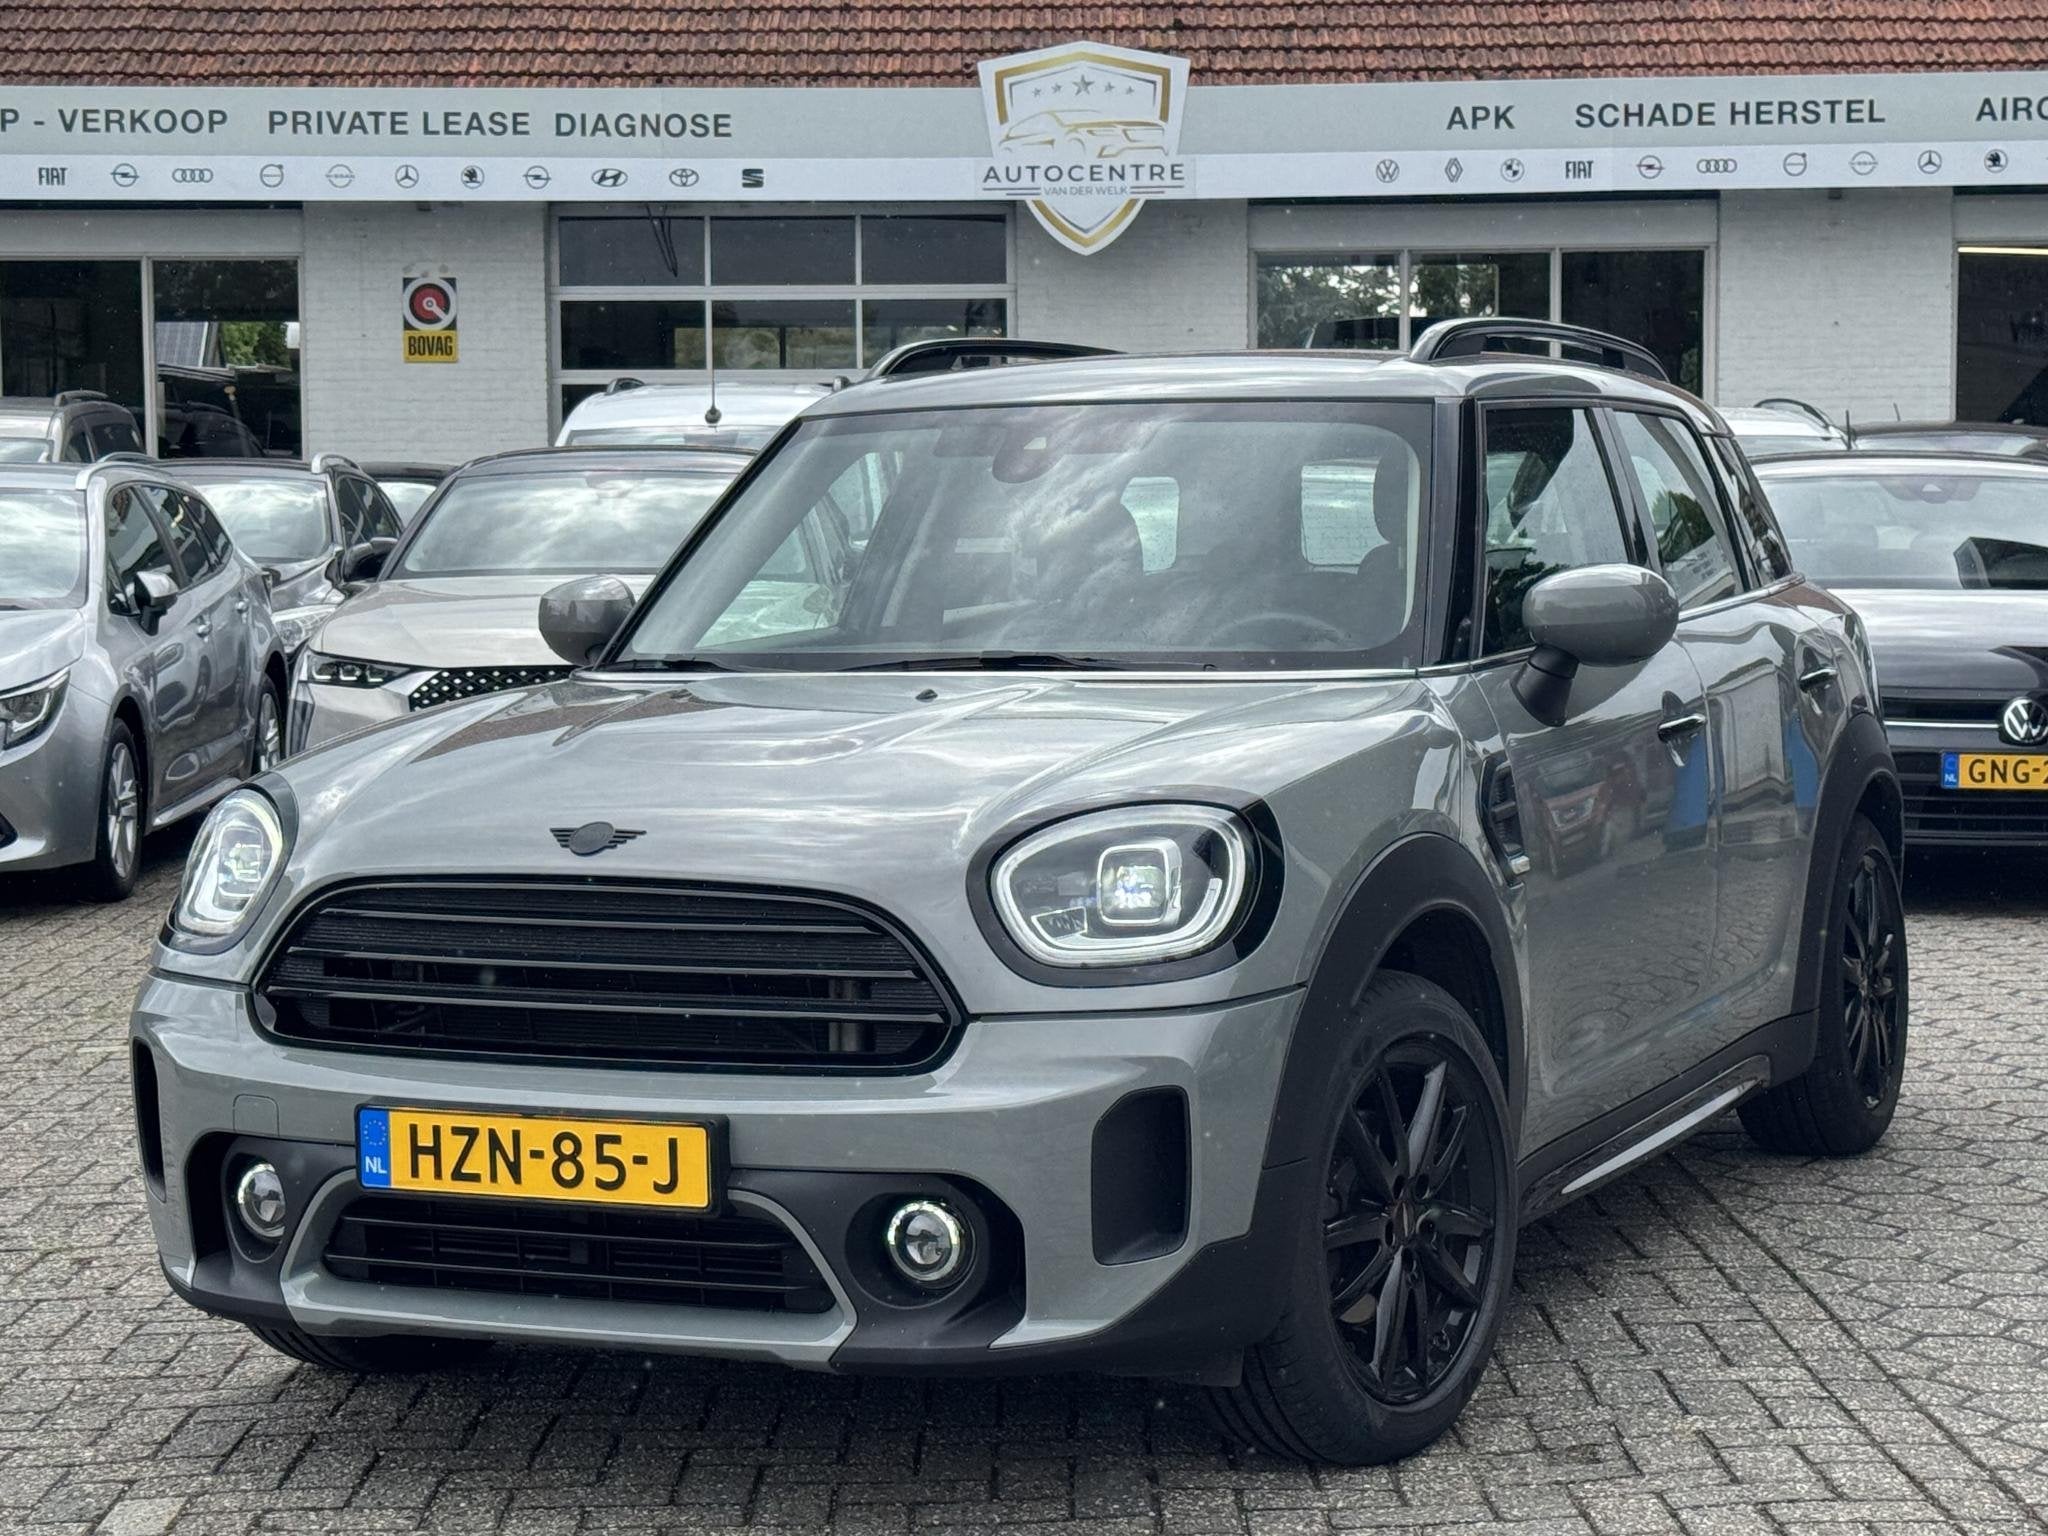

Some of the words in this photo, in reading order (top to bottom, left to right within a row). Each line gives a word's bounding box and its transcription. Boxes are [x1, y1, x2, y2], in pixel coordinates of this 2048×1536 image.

[0, 108, 20, 133] P
[58, 108, 228, 134] VERKOOP
[268, 110, 409, 136] PRIVATE
[422, 111, 530, 137] LEASE
[555, 112, 732, 138] DIAGNOSE
[1446, 105, 1515, 130] APK
[1575, 102, 1716, 128] SCHADE
[1730, 99, 1885, 126] HERSTEL
[38, 167, 68, 186] FIAT
[982, 163, 1185, 184] AUTOCENTRE
[1565, 160, 1594, 179] FIAT
[1043, 187, 1068, 196] VAN
[1069, 186, 1092, 195] DER
[1094, 185, 1128, 195] WELK
[407, 335, 454, 356] BOVAG
[364, 1155, 388, 1175] NL
[408, 1122, 679, 1195] HZN-85-J
